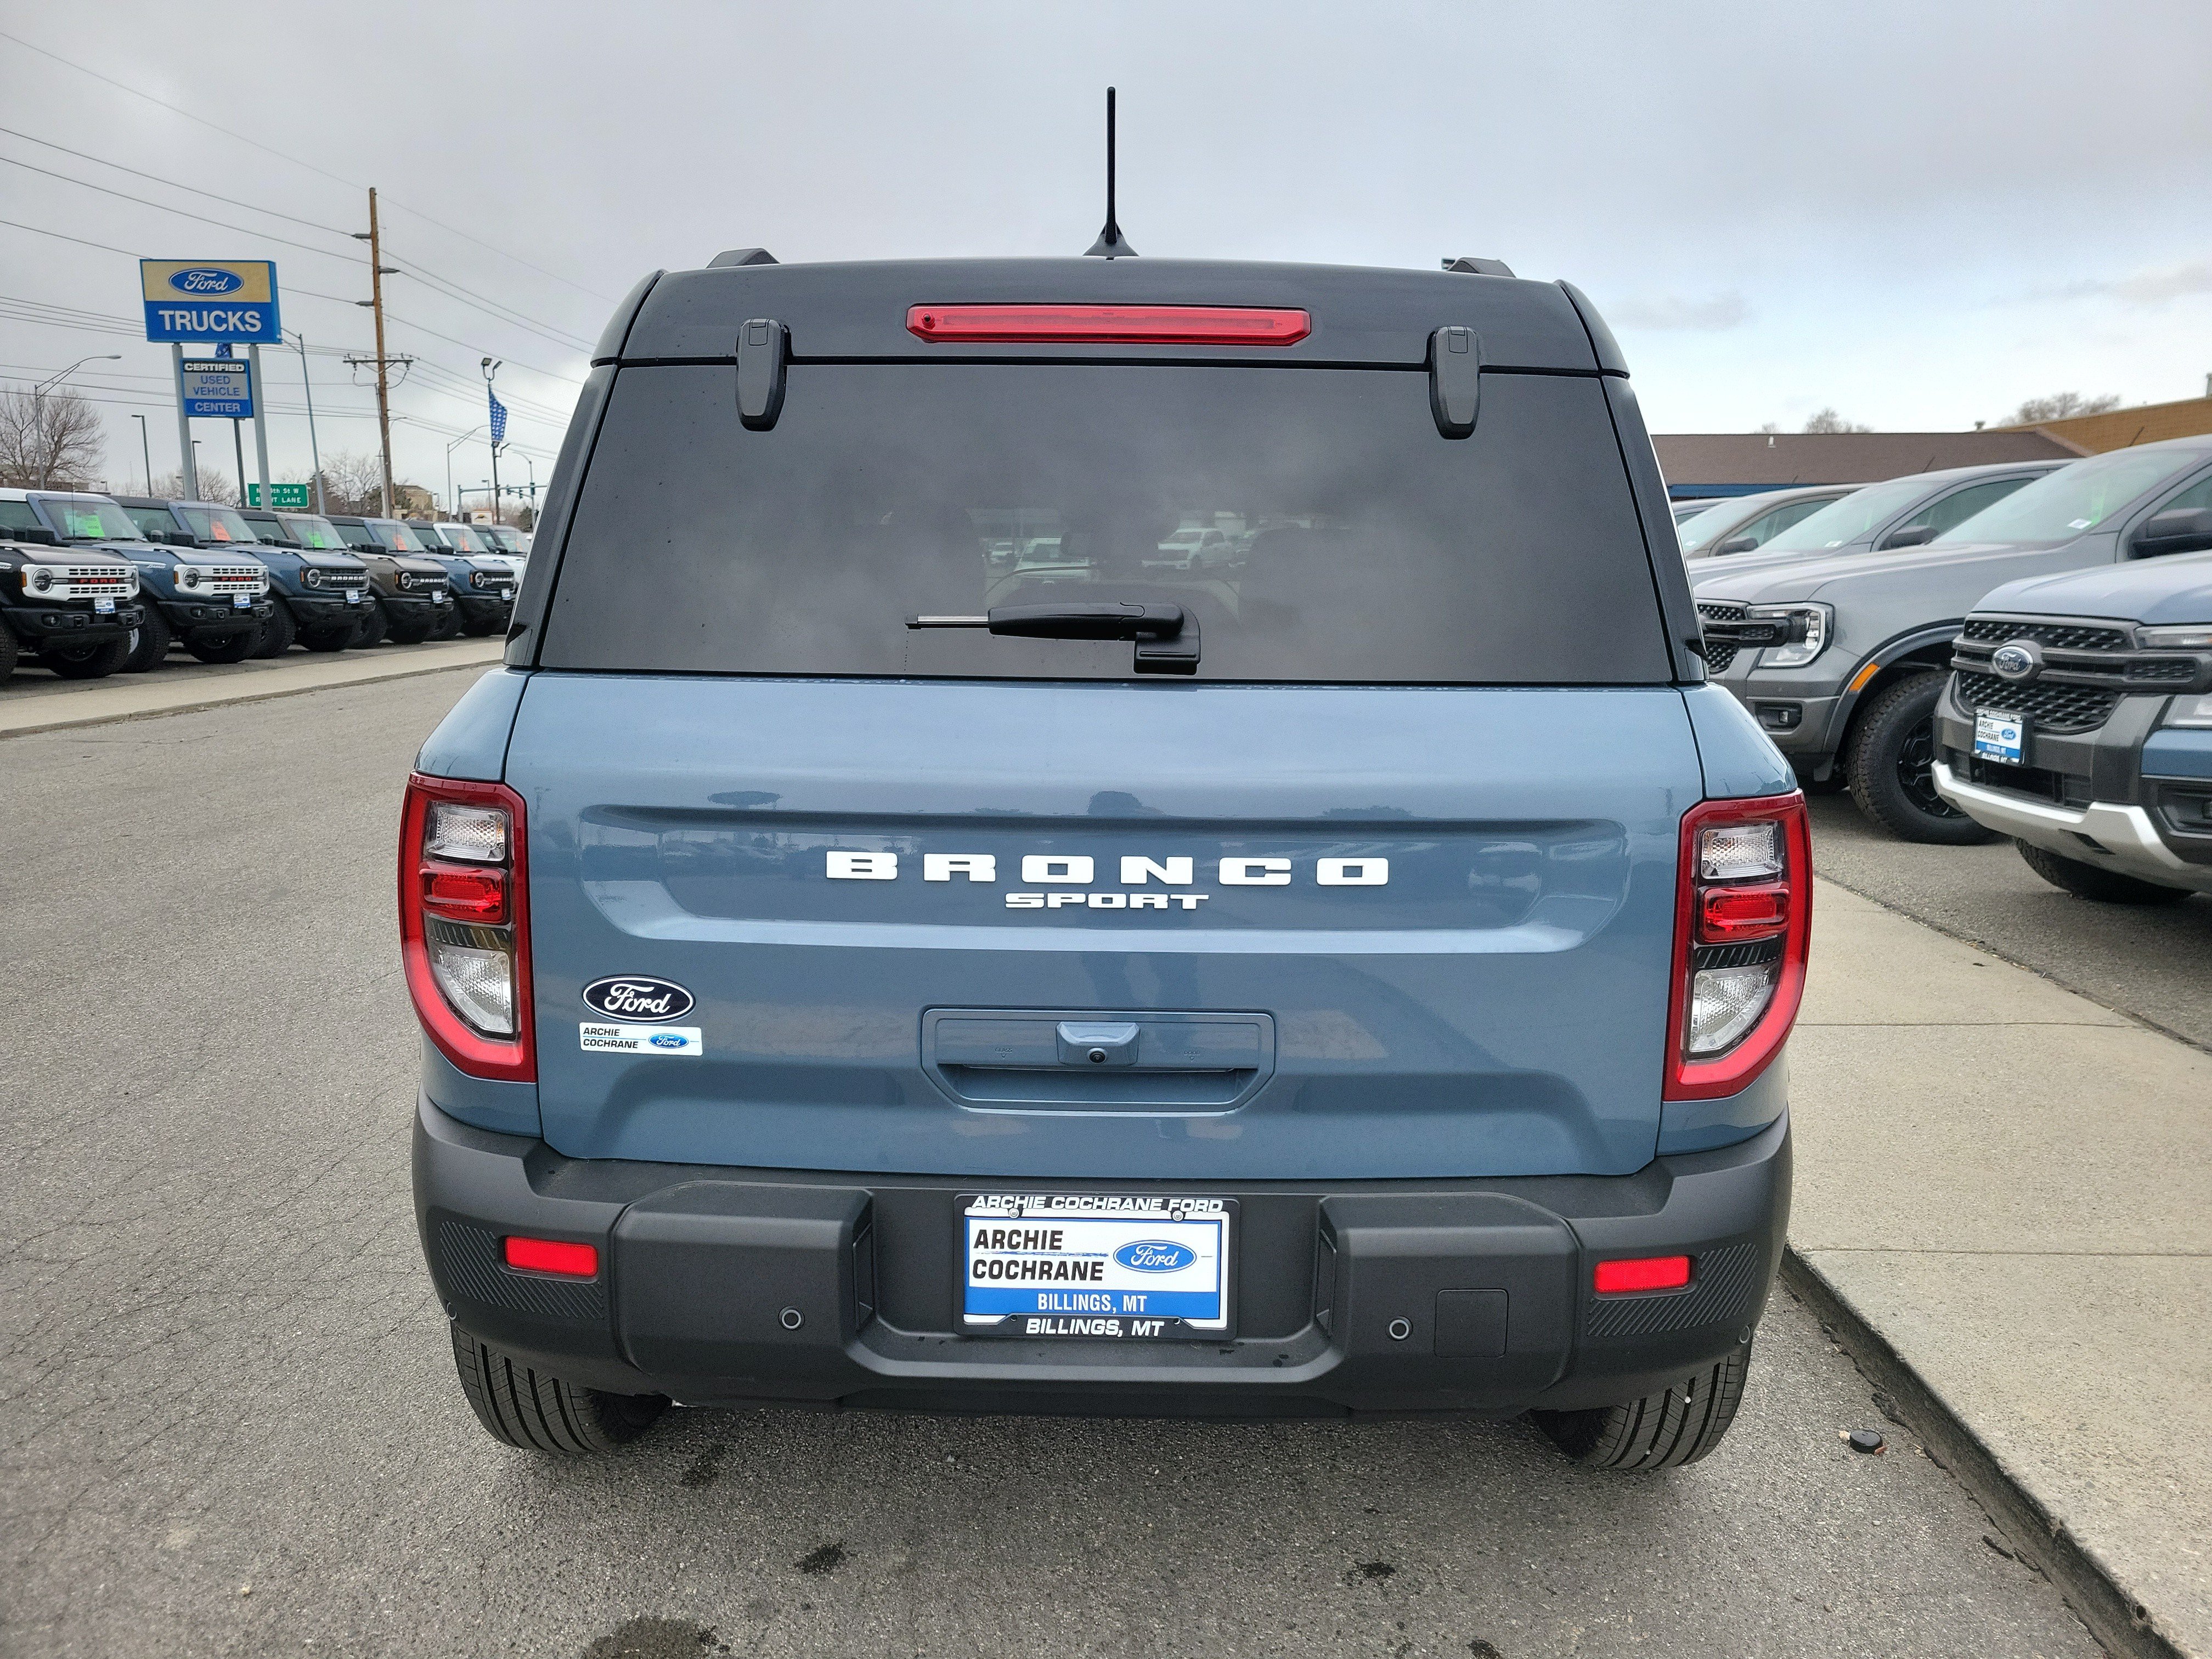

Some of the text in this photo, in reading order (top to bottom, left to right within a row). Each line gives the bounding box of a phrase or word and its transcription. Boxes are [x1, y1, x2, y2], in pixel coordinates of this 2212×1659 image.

[184, 271, 228, 291] Ford
[158, 310, 262, 332] TRUCKS
[184, 363, 245, 373] CERTIFIED
[200, 375, 230, 385] USED
[193, 387, 240, 396] VEHICLE
[195, 402, 241, 413] CENTER
[2000, 652, 2022, 671] Ford
[1979, 720, 1994, 730] ARCHIE
[1978, 730, 2000, 742] COCHRANE
[826, 850, 1389, 886] BRONCO
[1005, 893, 1210, 910] SPORT
[604, 983, 673, 1013] Ford
[583, 1027, 620, 1036] ARCHIE
[583, 1039, 639, 1049] COCHRANE
[656, 1035, 681, 1047] Ford
[972, 1195, 1224, 1213] ARCHIE COCHRANE FORD
[973, 1229, 1063, 1250] ARCHIE
[1130, 1244, 1179, 1267] Ford
[972, 1259, 1104, 1281] COCHRANE
[1037, 1293, 1147, 1314] BILLINGS, MT
[1025, 1318, 1164, 1338] BILLINGS, MT
